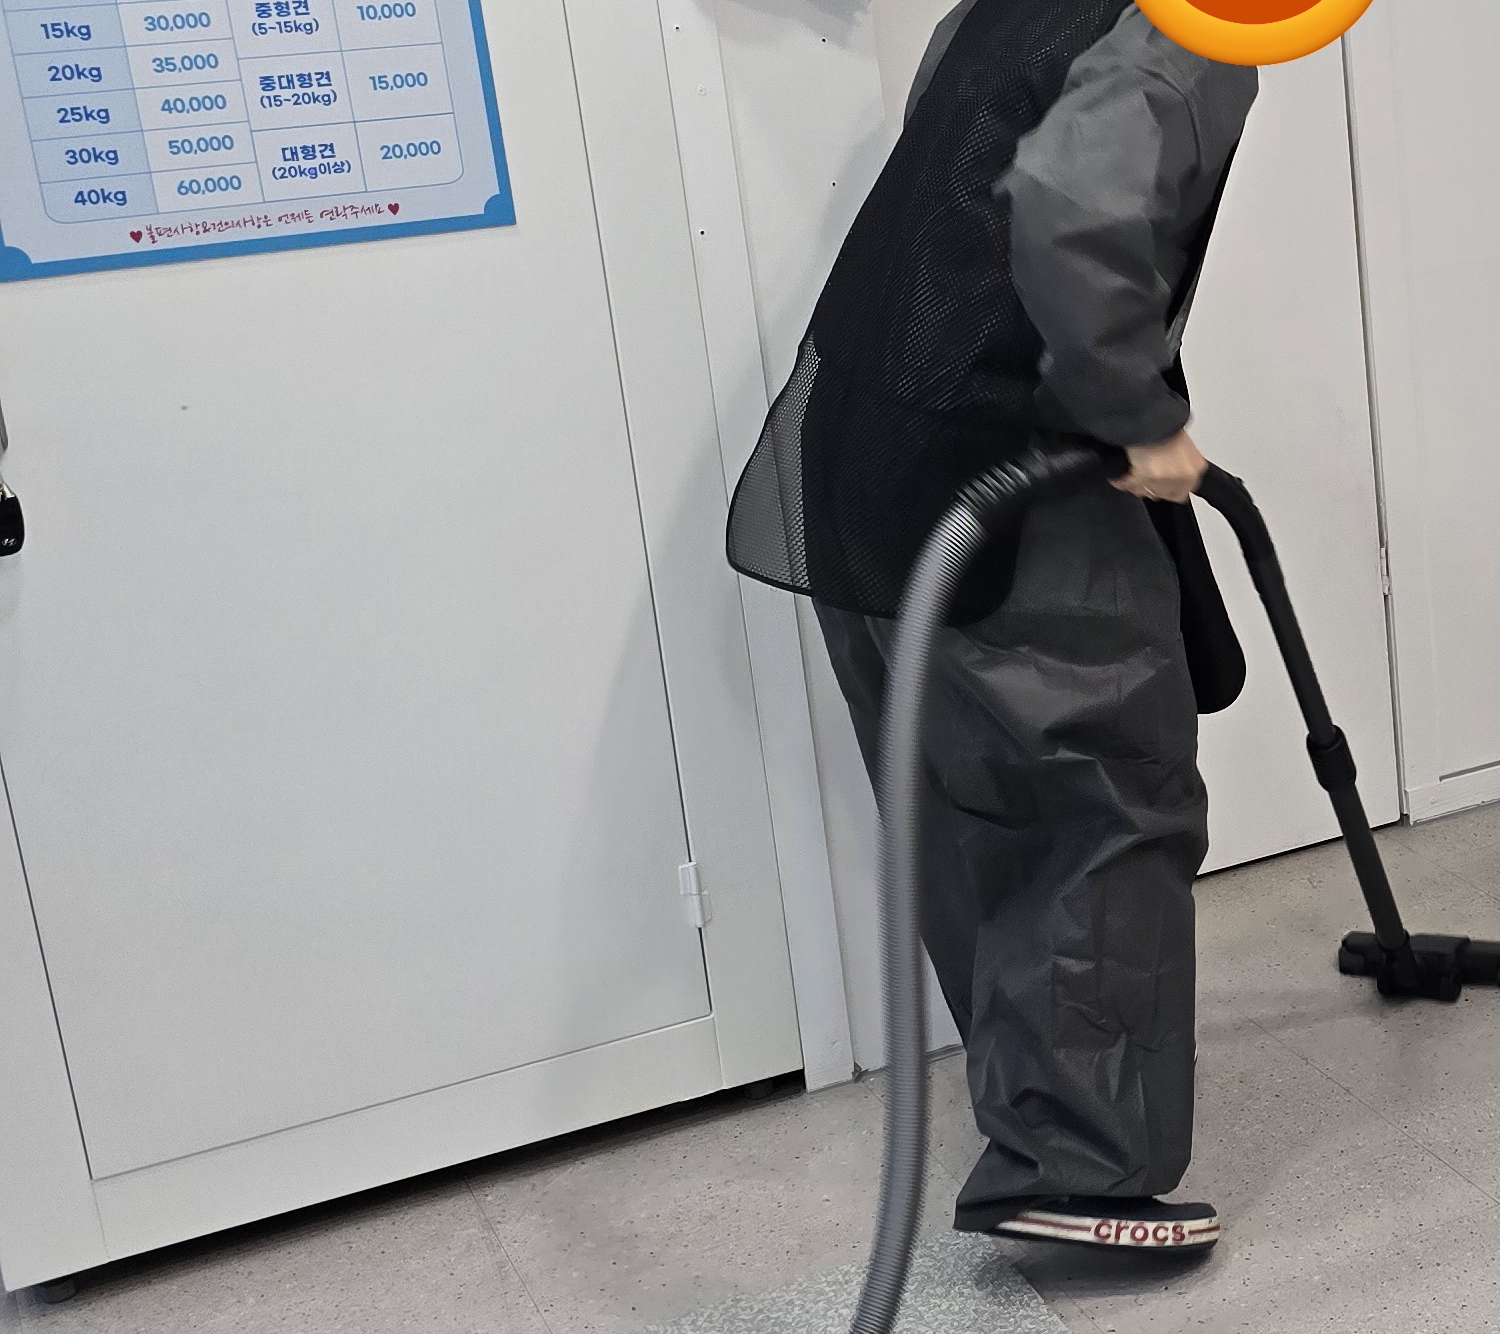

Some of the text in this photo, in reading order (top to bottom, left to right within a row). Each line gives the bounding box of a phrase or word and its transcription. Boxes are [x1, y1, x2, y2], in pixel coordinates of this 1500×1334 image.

[254, 0, 311, 18] 중형견
[356, 2, 417, 22] 10,000
[40, 21, 92, 42] 15kg
[143, 12, 212, 33] 30,000
[47, 63, 103, 84] 20kg
[151, 53, 220, 74] 35,000
[258, 71, 333, 92] 중대형견
[368, 72, 429, 92] 15,000
[160, 94, 228, 115] 40,000
[56, 105, 111, 126] 25kg
[168, 134, 235, 155] 50,000
[281, 142, 337, 162] 대형견
[379, 140, 442, 161] 20,000
[64, 146, 120, 168] 30kg
[271, 160, 352, 181] (20kg이상)
[176, 174, 243, 196] 60,000
[73, 188, 128, 208] 40kg
[1093, 1219, 1187, 1244] crocs
